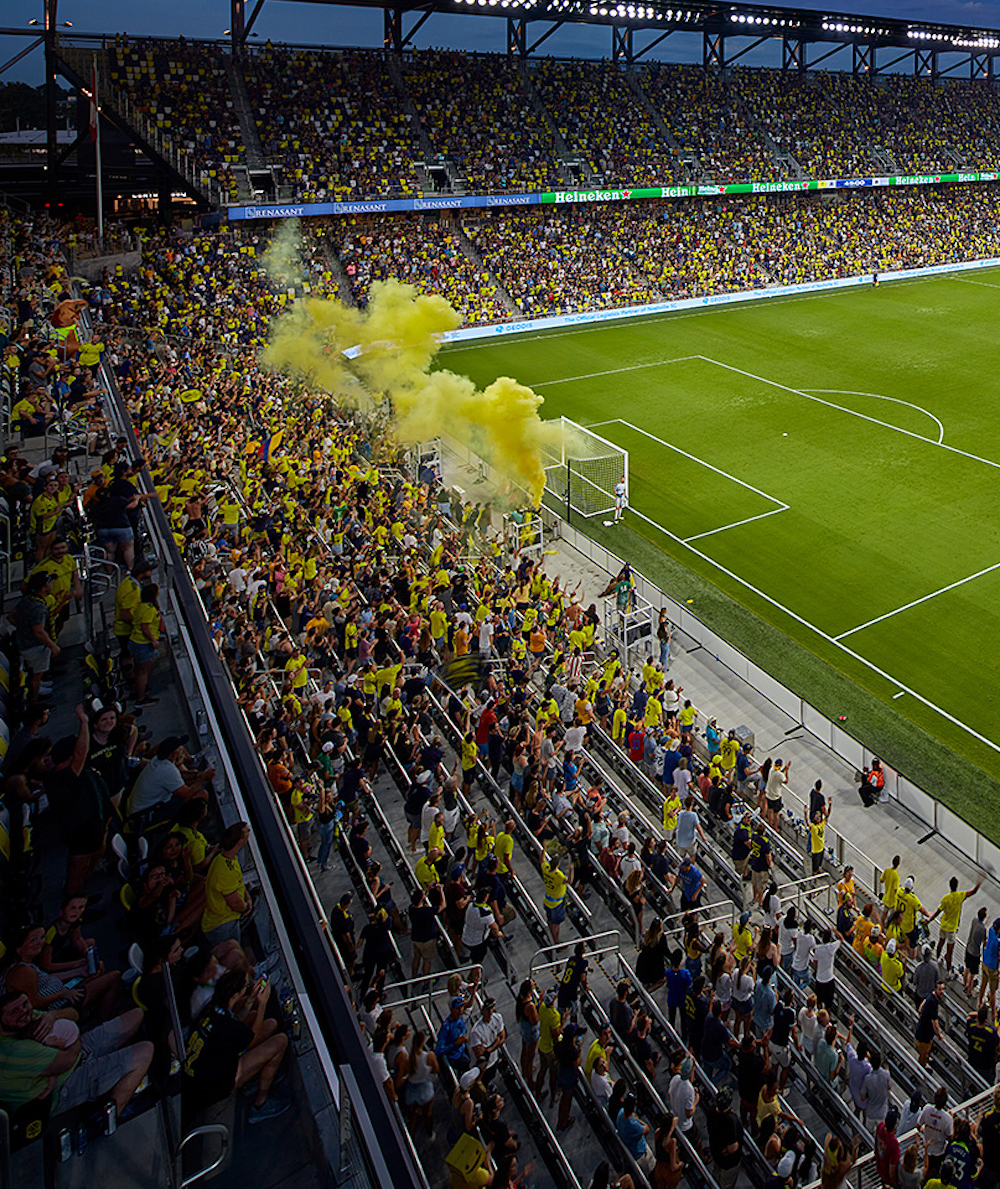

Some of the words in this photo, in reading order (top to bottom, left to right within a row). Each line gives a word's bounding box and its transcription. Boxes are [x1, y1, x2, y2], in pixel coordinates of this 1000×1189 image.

[895, 175, 934, 186] Heineken
[752, 181, 801, 193] Heineken
[555, 190, 620, 203] Heineken
[255, 207, 303, 217] RENASANT
[506, 322, 533, 331] GEODIS
